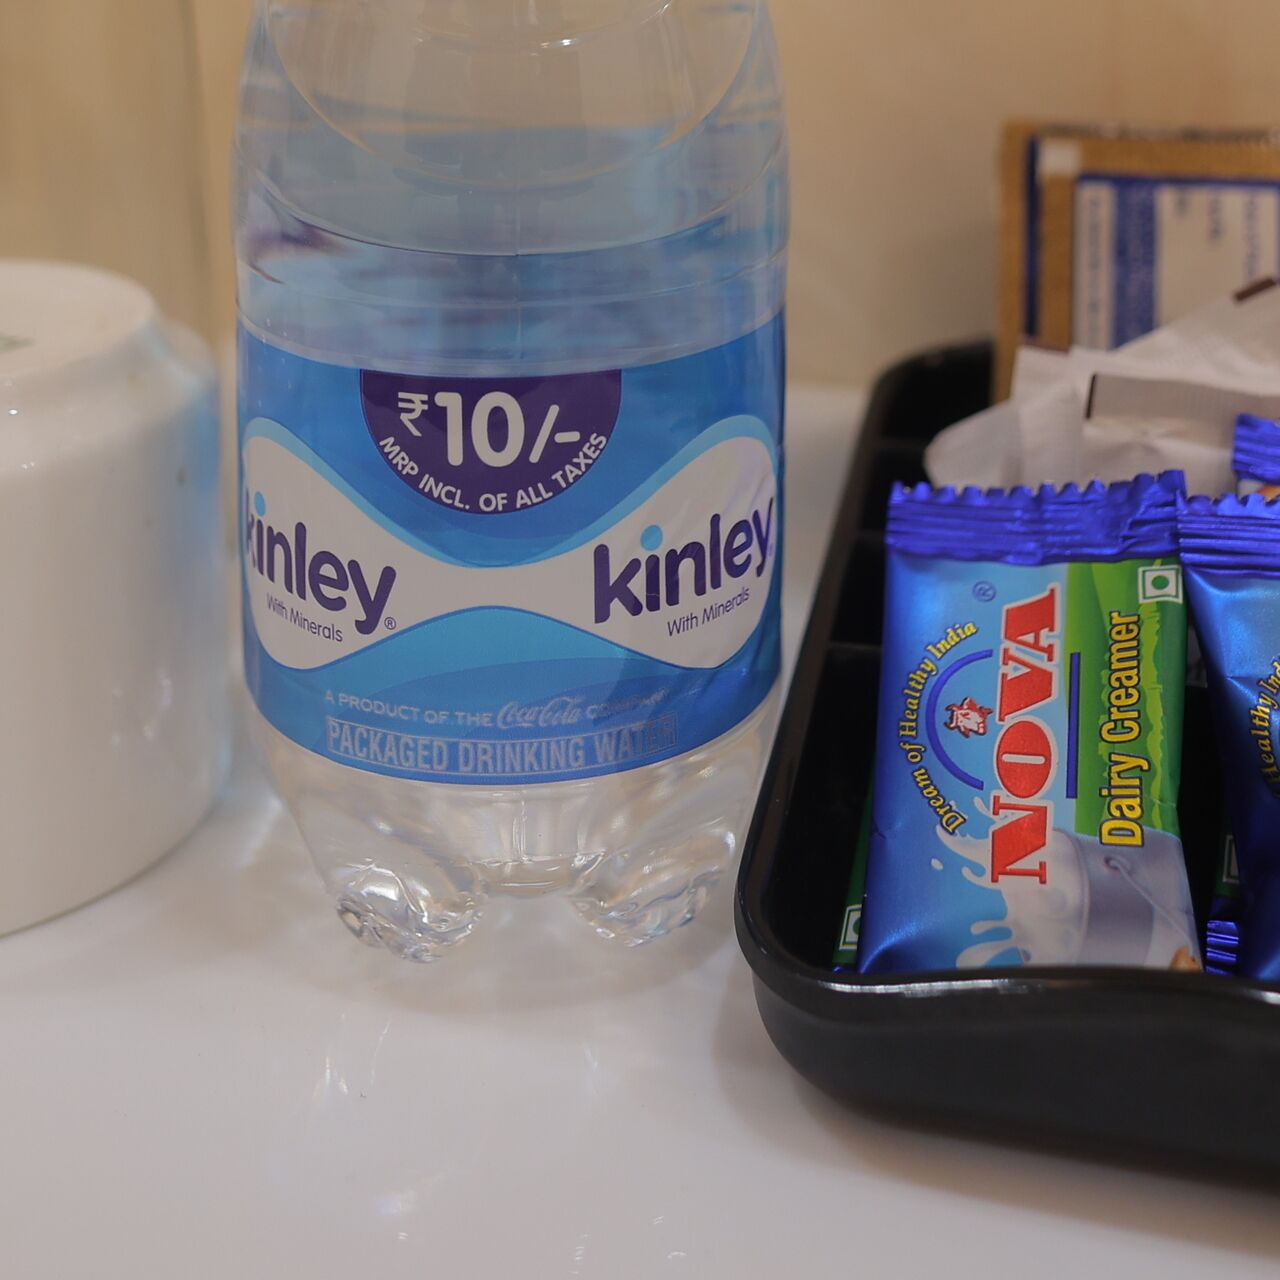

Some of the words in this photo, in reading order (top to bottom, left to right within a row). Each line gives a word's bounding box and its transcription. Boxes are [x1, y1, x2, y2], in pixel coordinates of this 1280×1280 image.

[379, 436, 420, 477] MRP
[418, 473, 471, 511] INCL.
[478, 492, 508, 512] OF
[515, 481, 553, 509] ALL
[551, 431, 608, 489] TAXES
[593, 496, 775, 624] kinley
[267, 591, 288, 619] With
[289, 606, 345, 643] Minerals
[667, 612, 700, 637] With
[701, 585, 751, 626] Minerals
[924, 620, 979, 661] India
[325, 688, 336, 705] A
[338, 692, 421, 722] PRODUCT
[423, 709, 451, 726] OF
[454, 710, 494, 728] THE
[899, 655, 940, 738] Healthy
[1098, 609, 1143, 745] Creamer
[327, 720, 449, 771] PACKAGED
[457, 739, 586, 774] DRINKING
[898, 738, 928, 764] of
[989, 583, 1059, 887] NOVA
[911, 766, 968, 836] Dream
[1098, 752, 1151, 848] Dairy
